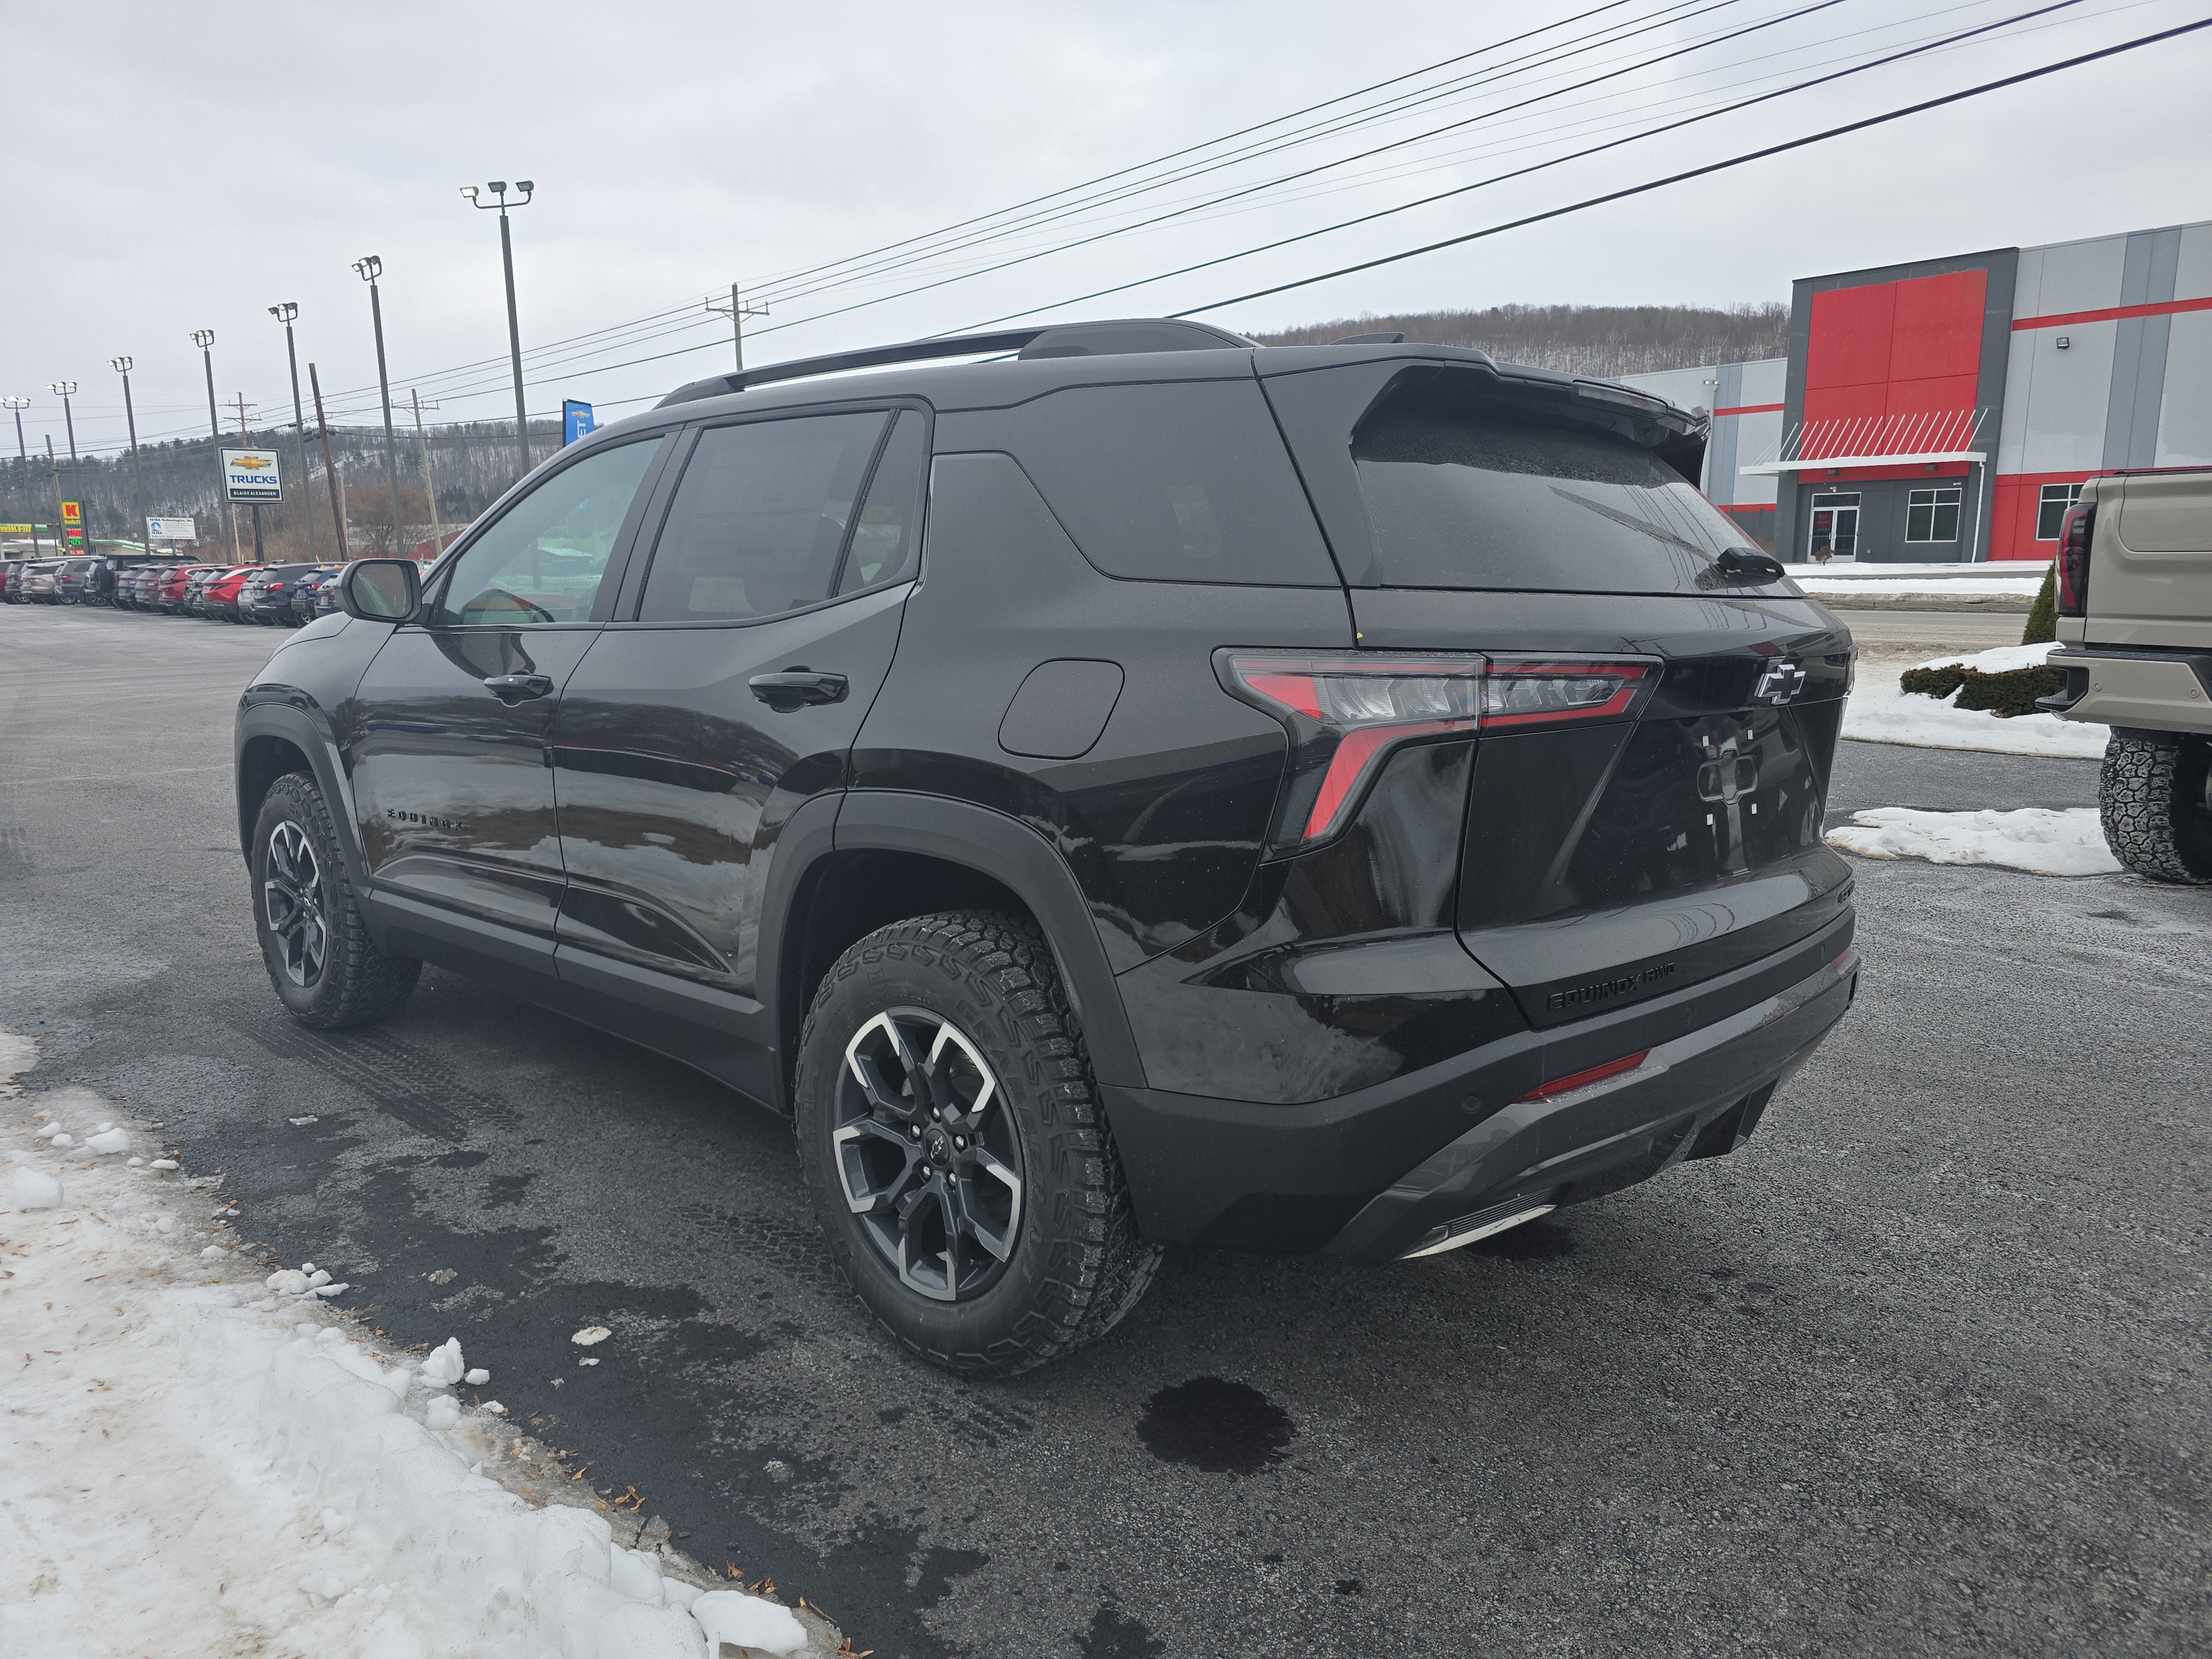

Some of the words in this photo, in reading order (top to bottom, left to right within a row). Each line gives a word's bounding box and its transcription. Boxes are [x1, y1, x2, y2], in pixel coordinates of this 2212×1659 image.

[577, 420, 586, 438] ET
[229, 475, 277, 484] TRUCKS
[65, 505, 79, 517] K
[1547, 974, 1642, 1011] EQUINOX
